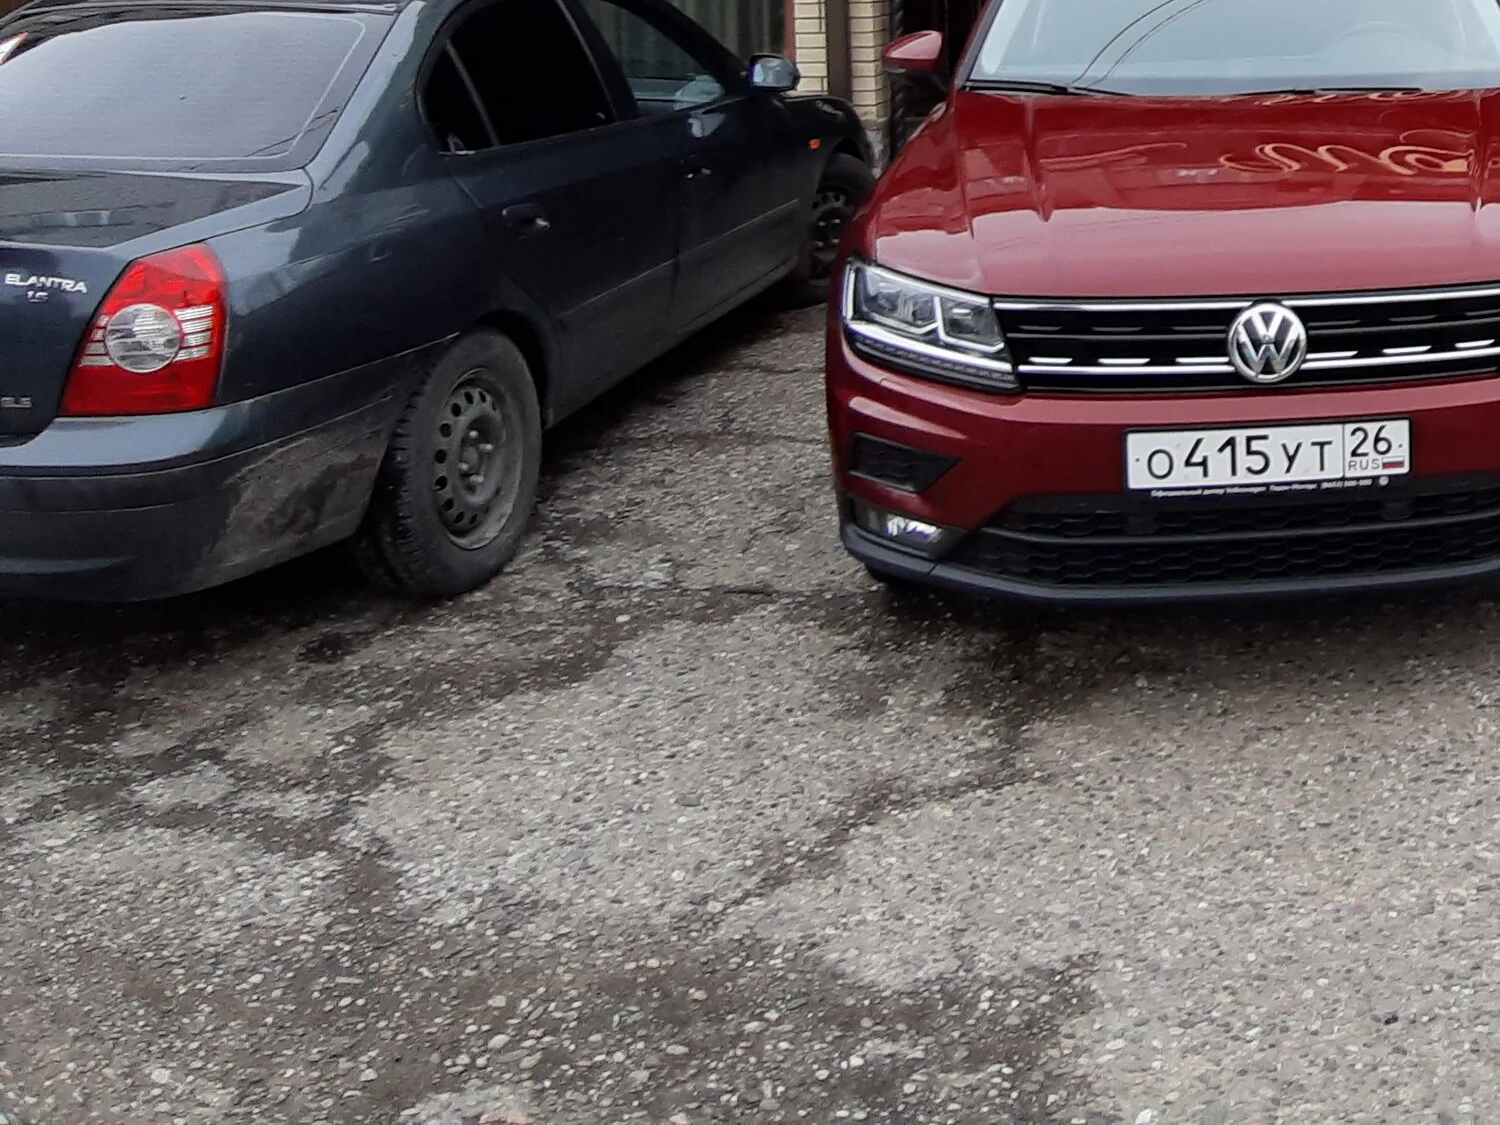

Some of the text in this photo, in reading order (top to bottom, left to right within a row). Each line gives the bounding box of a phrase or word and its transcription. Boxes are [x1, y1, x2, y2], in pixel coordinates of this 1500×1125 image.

[4, 273, 88, 294] ELANTRA
[1350, 424, 1393, 458] 26
[1348, 457, 1380, 472] RUS
